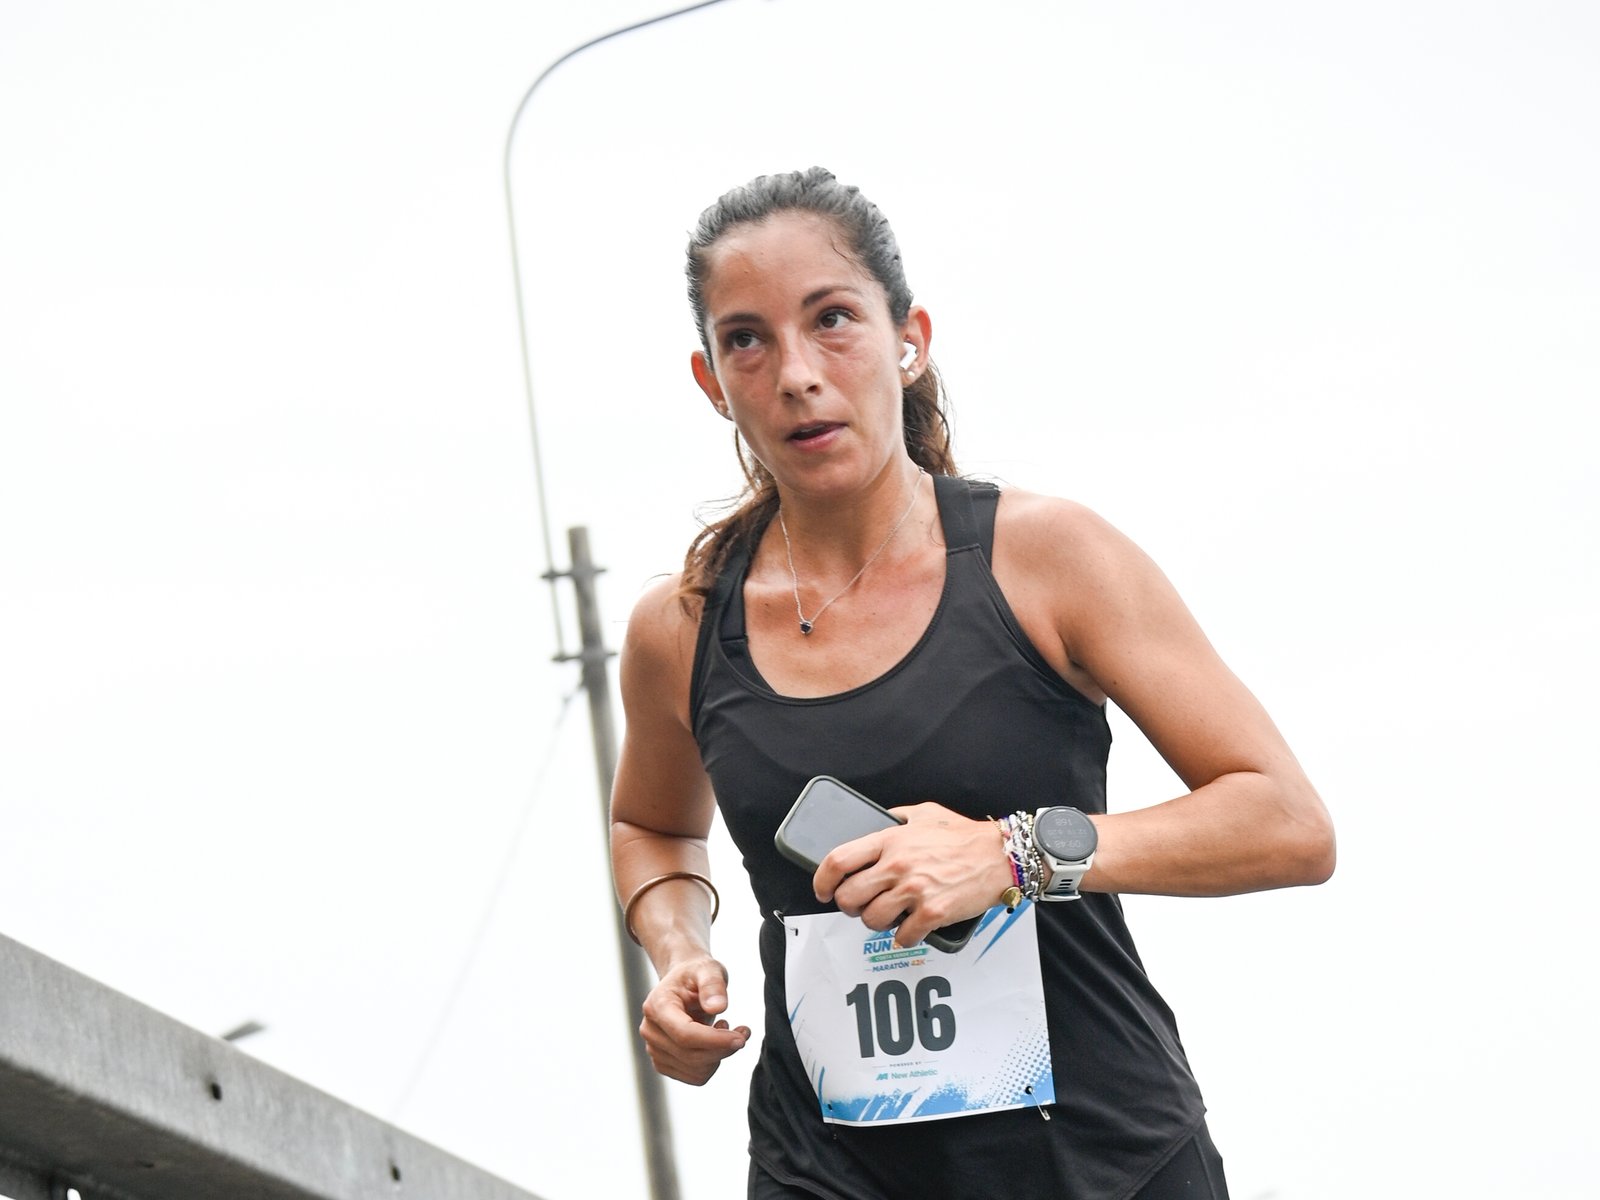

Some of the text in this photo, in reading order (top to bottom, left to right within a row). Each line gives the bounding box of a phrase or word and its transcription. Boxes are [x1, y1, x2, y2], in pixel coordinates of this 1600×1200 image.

[863, 940, 892, 955] RUN
[846, 976, 956, 1058] 106
[891, 1071, 908, 1080] New
[909, 1068, 938, 1078] Athletic
